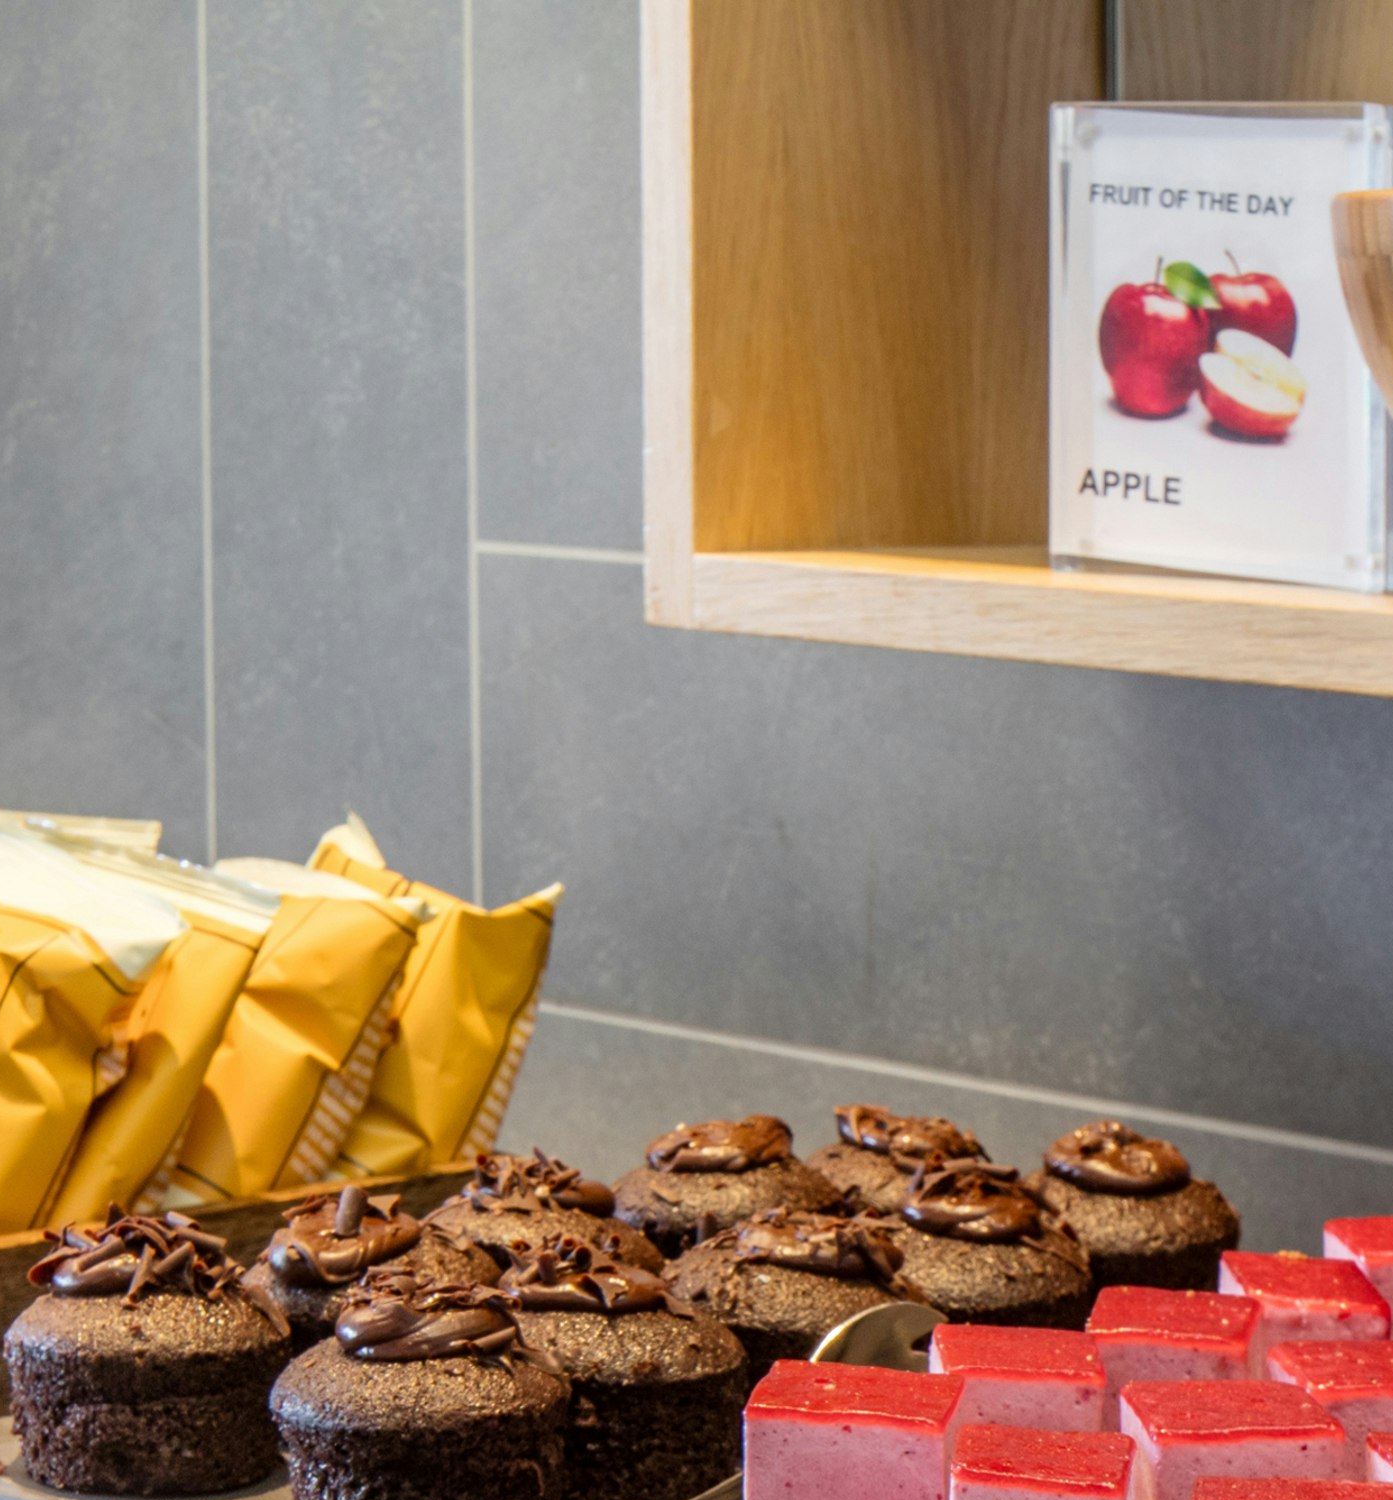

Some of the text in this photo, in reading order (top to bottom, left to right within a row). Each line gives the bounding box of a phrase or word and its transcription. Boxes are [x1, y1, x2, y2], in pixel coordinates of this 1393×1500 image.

[1089, 183, 1295, 217] FRUIT OF THE DAY
[1079, 468, 1182, 505] APPLE
